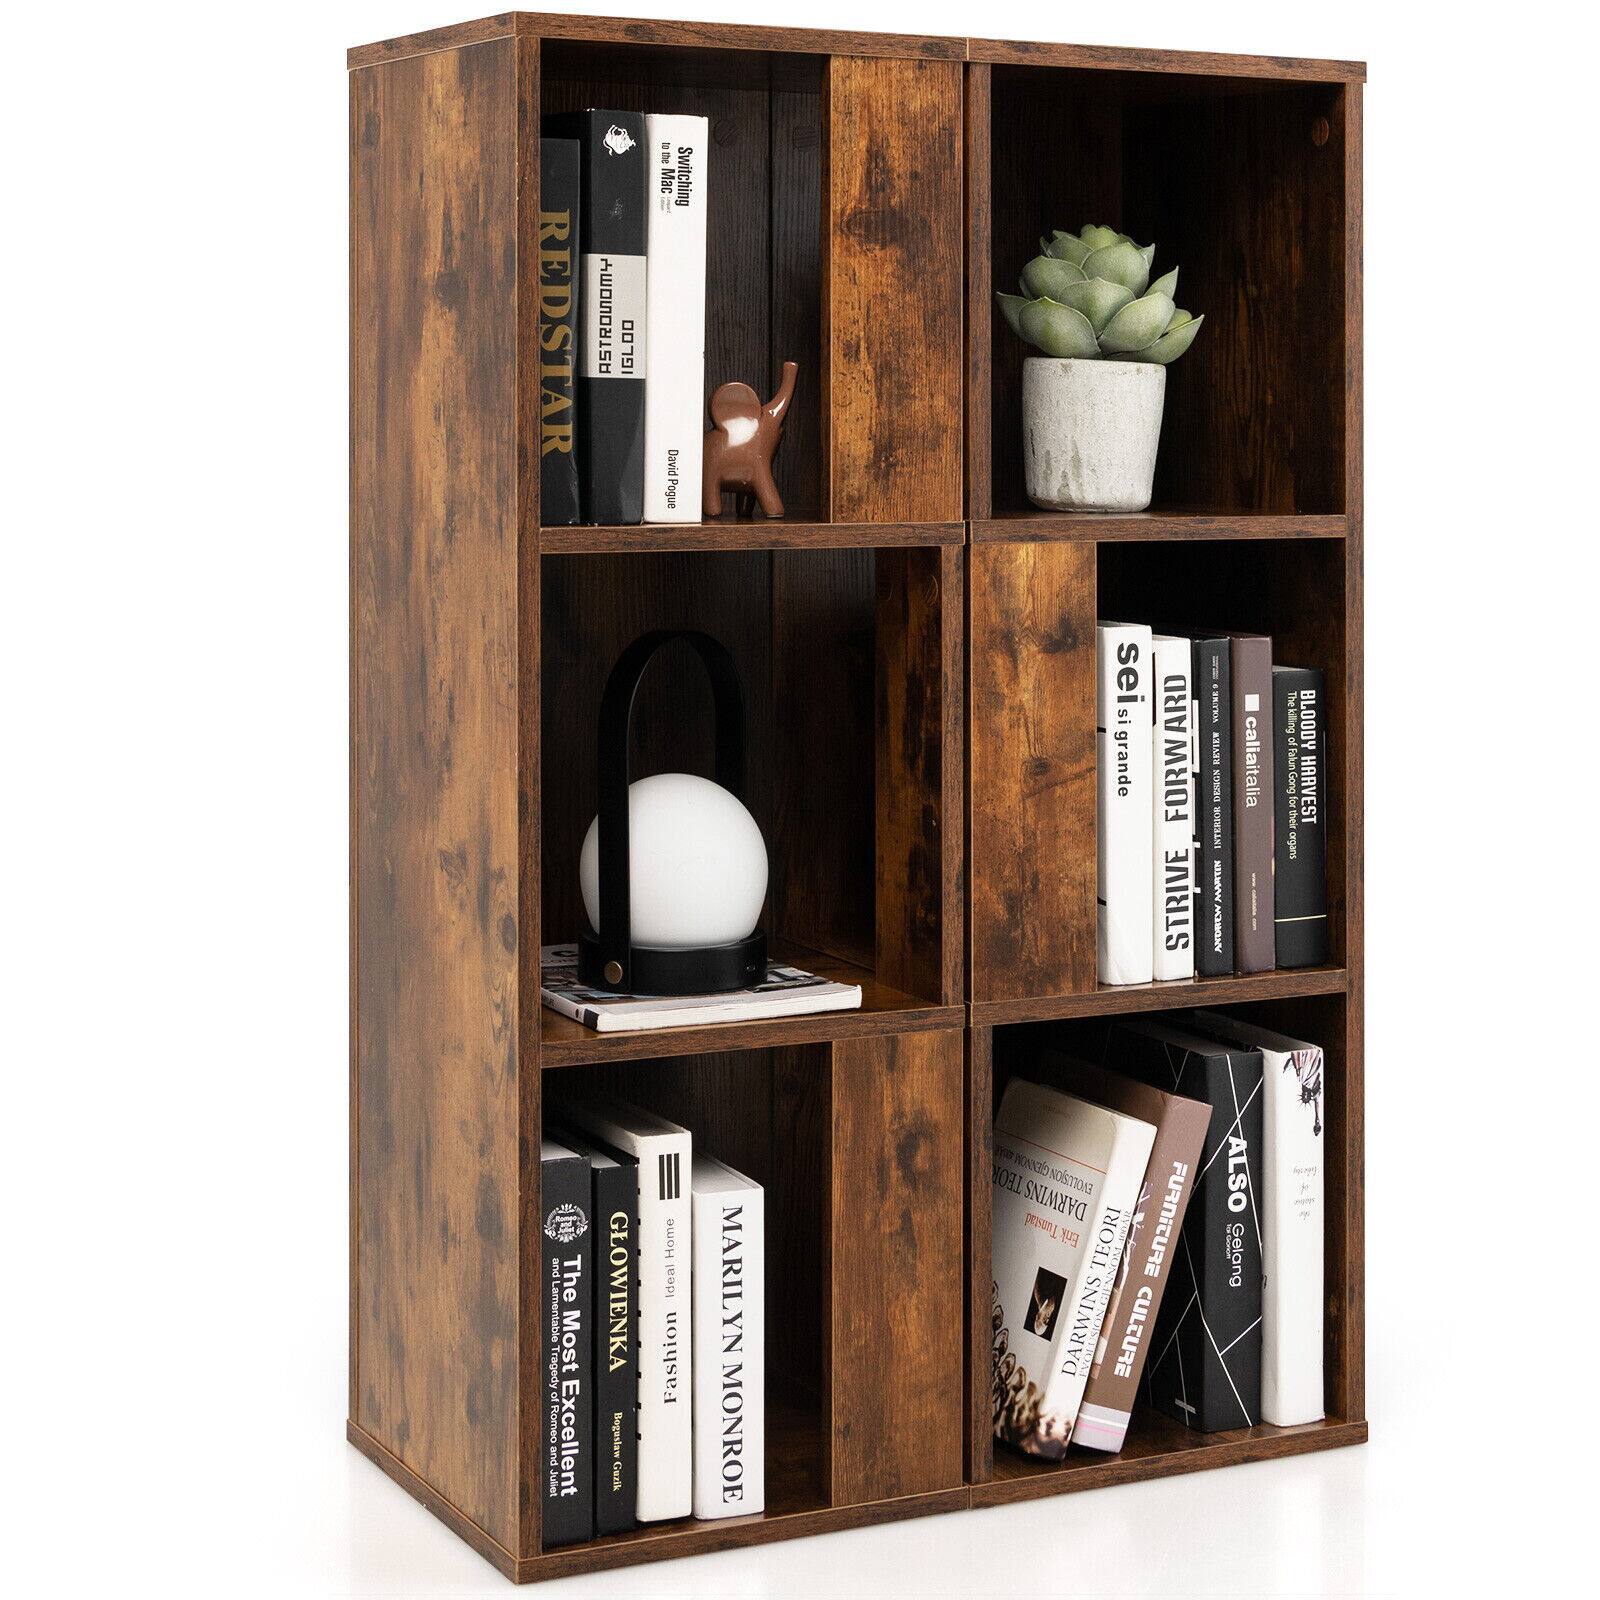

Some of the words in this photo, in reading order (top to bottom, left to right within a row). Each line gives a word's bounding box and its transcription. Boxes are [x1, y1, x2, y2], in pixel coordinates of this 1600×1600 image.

[661, 142, 671, 150] to
[661, 152, 671, 164] the
[661, 168, 676, 194] Mac
[675, 146, 693, 206] Switching
[540, 208, 573, 458] REDSTAR
[599, 258, 613, 374] ASTRONOMY
[621, 320, 634, 374] IGLOO
[667, 449, 679, 476] David
[664, 479, 678, 509] Pogue
[1117, 642, 1145, 702] sei
[1118, 709, 1131, 724] si
[1288, 691, 1297, 707] The
[1286, 708, 1298, 734] killing
[1300, 689, 1316, 751] BLOODY
[1164, 674, 1188, 822] FORWARD
[1212, 732, 1220, 765] REVIEW
[1287, 748, 1297, 770] Falun
[1288, 737, 1298, 747] of
[1115, 731, 1132, 797] grande
[1245, 716, 1261, 808] caliaitalia
[1213, 767, 1221, 801] DESIGN
[1286, 772, 1297, 794] Gong
[1289, 796, 1298, 808] for
[1300, 756, 1317, 824] HARVEST
[1213, 805, 1221, 849] INTERIOR
[1288, 810, 1298, 830] their
[1287, 832, 1297, 860] organs
[1165, 849, 1189, 951] STRIVE
[1214, 904, 1222, 953] ANDREW
[991, 1162, 1022, 1195] TEOR
[1049, 1168, 1094, 1195] EVOLUSJON
[1227, 1136, 1248, 1213] ALSO
[1024, 1180, 1088, 1221] DARWINS
[665, 1218, 675, 1258] Home
[1024, 1213, 1057, 1239] Tunstad
[1060, 1226, 1080, 1248] Erik
[552, 1258, 560, 1278] and
[1229, 1223, 1244, 1288] Gelang
[563, 1254, 581, 1302] The
[609, 1211, 629, 1373] GŁOWIENKA
[665, 1264, 675, 1298] Ideal
[722, 1205, 743, 1353] MARILYN
[1061, 1275, 1102, 1378] DARWINS
[1090, 1206, 1121, 1270] TEORI
[550, 1280, 560, 1343] Lamentable
[562, 1310, 580, 1373] Most
[663, 1311, 677, 1404] Fashion
[549, 1345, 560, 1389] Tragedy
[550, 1391, 559, 1403] of
[550, 1405, 559, 1444] Romeo
[560, 1379, 580, 1497] Excellent
[722, 1362, 743, 1503] MONROE
[550, 1445, 558, 1467] and
[549, 1468, 559, 1498] Juliet
[612, 1461, 622, 1492] Guzik
